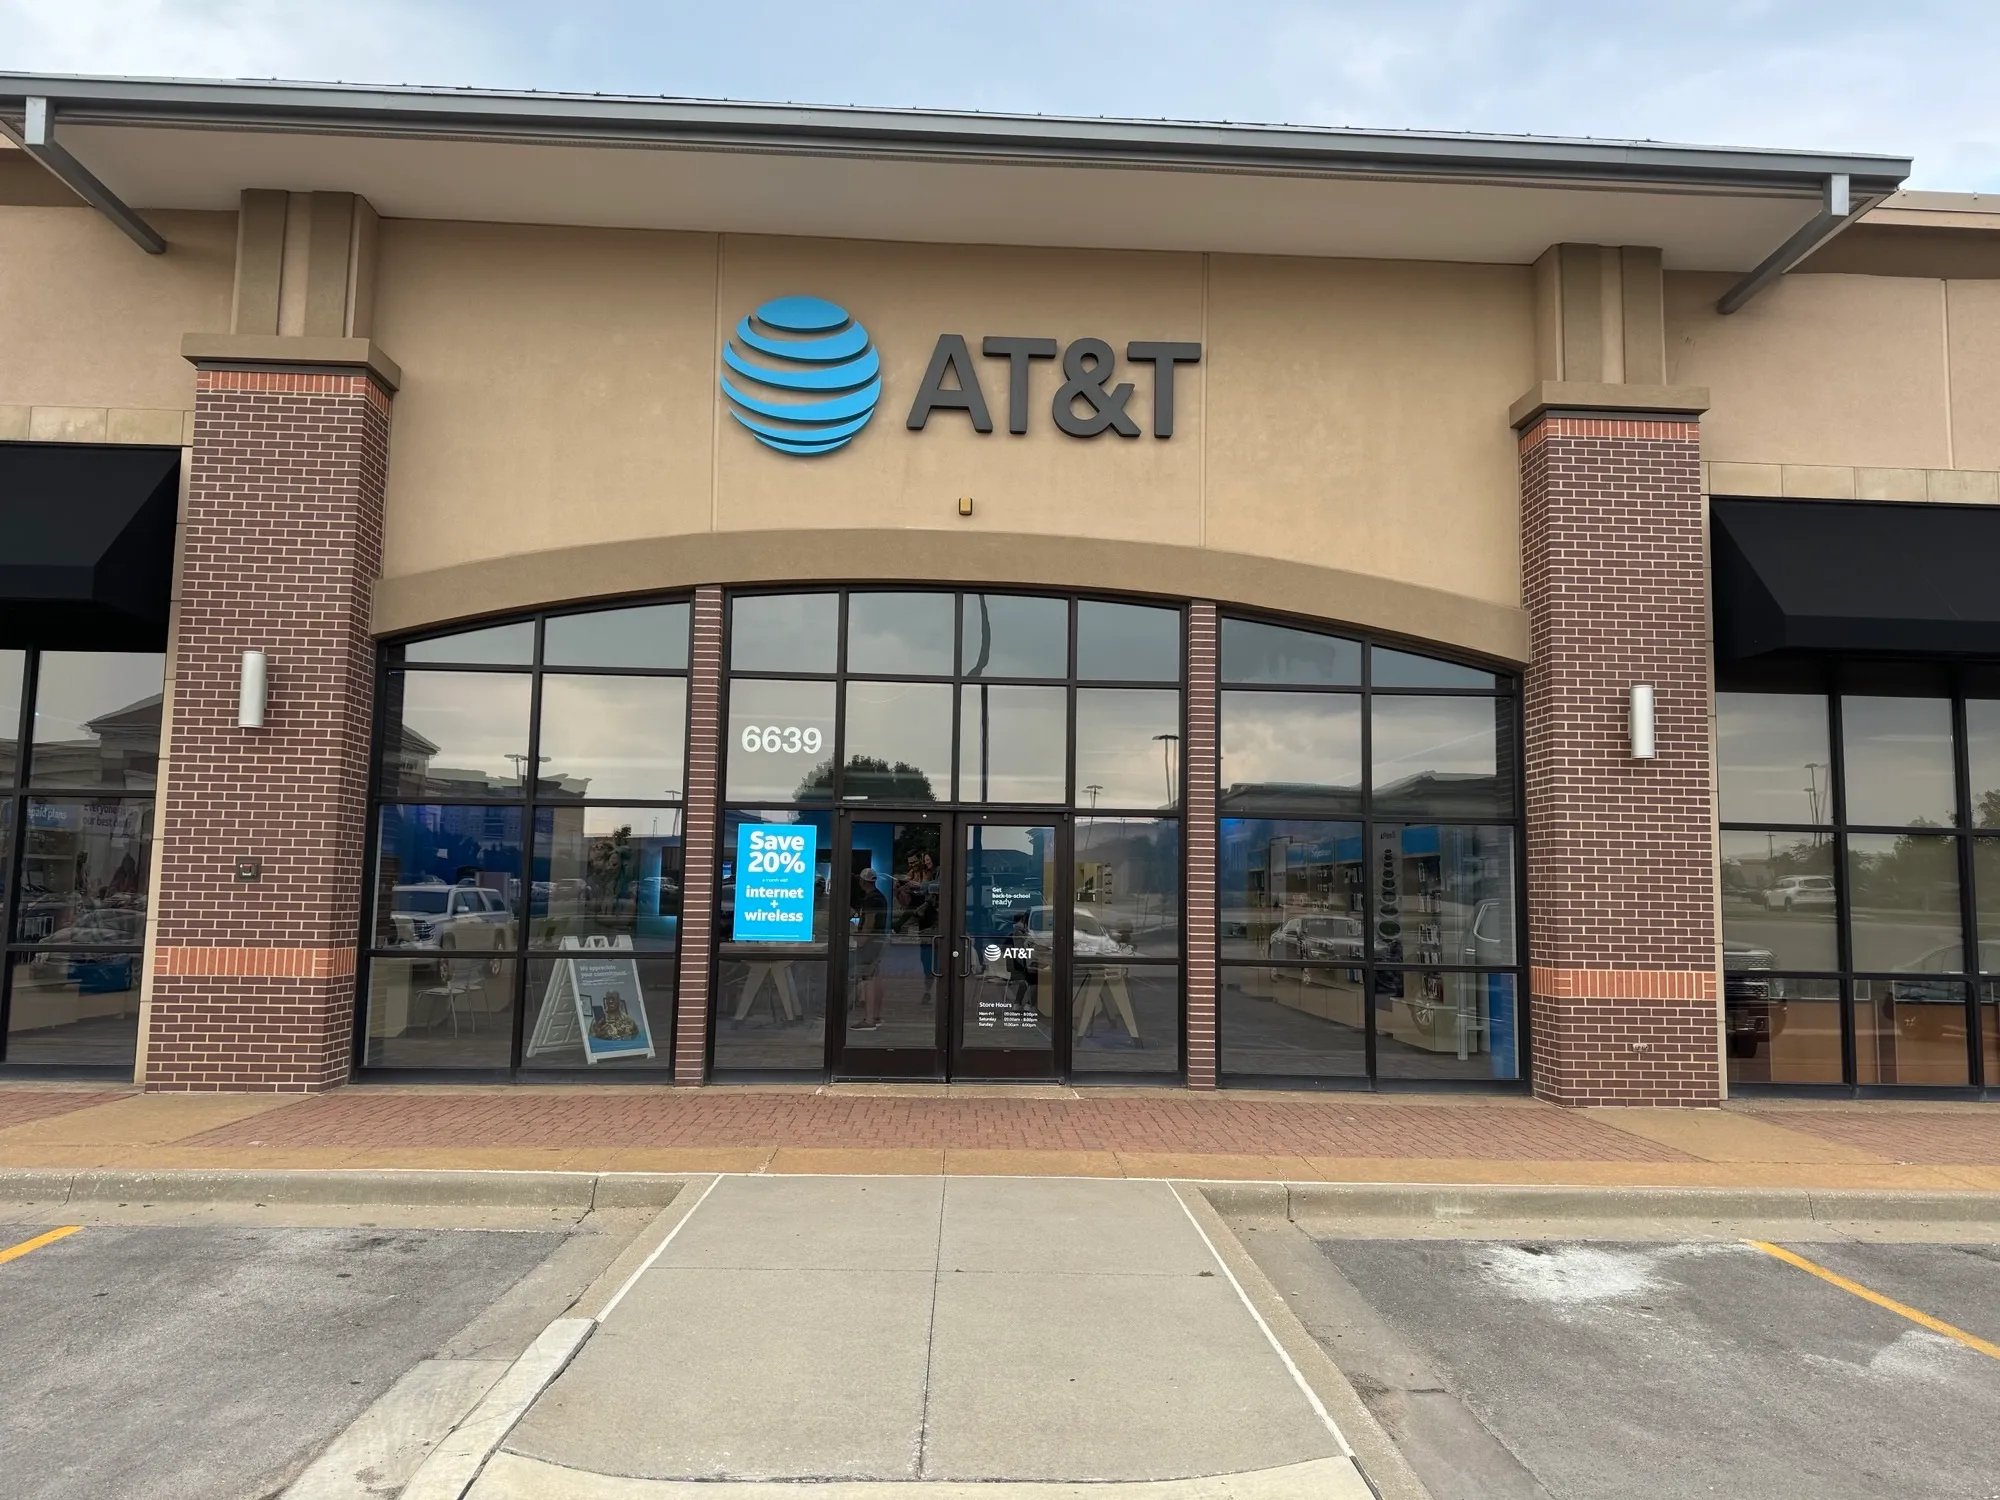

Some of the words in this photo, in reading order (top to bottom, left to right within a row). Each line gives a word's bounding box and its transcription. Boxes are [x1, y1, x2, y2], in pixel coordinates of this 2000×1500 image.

[906, 333, 1202, 439] AT&T
[741, 725, 823, 754] 6639
[47, 808, 68, 820] plans
[83, 817, 96, 825] our
[97, 815, 112, 827] best
[749, 830, 805, 851] Save
[747, 851, 806, 873] 20%
[745, 885, 805, 899] internet
[992, 899, 1013, 908] ready
[744, 909, 804, 922] wireless
[1003, 947, 1035, 959] AT&T
